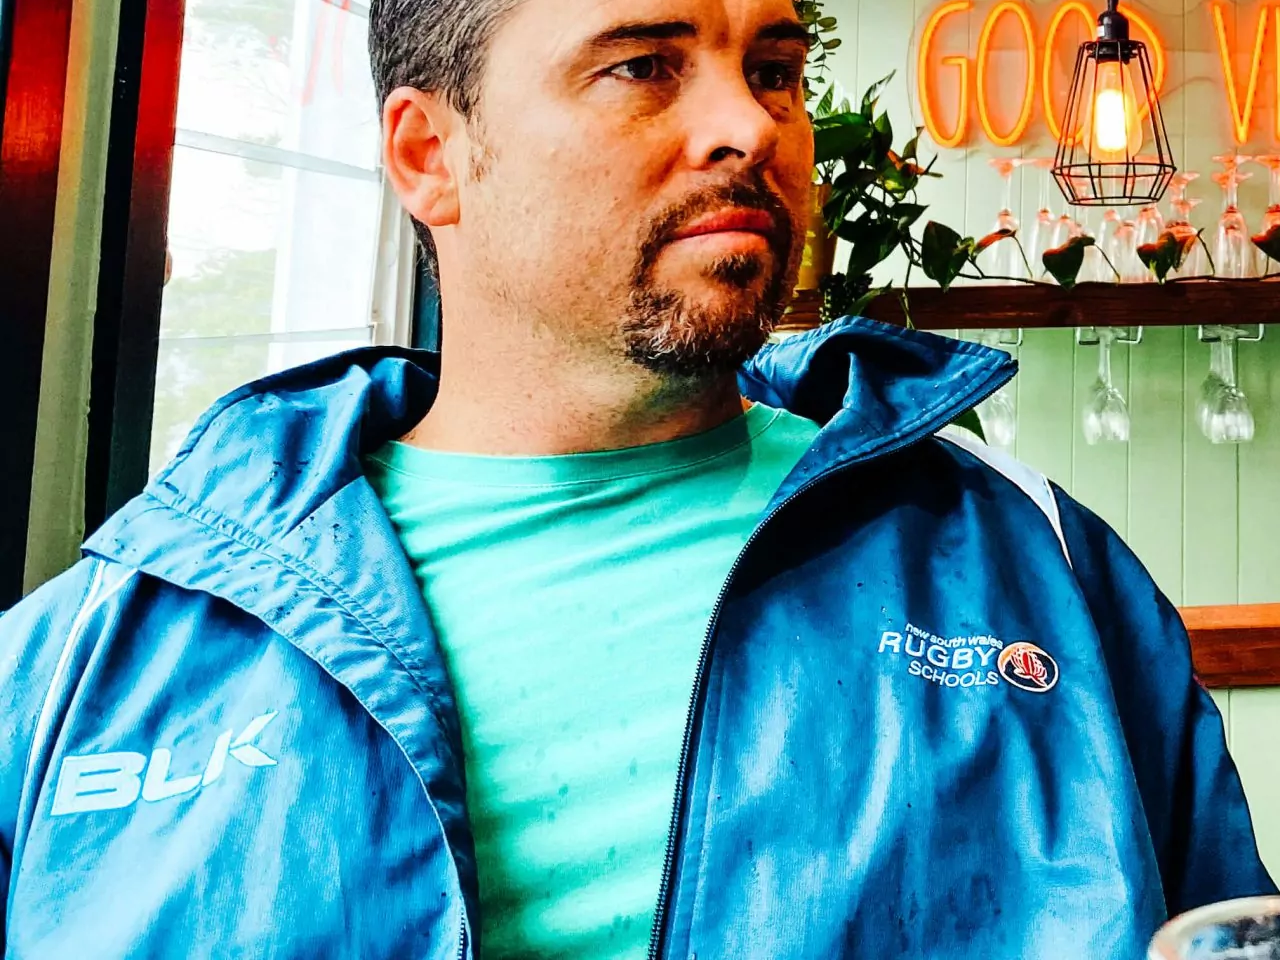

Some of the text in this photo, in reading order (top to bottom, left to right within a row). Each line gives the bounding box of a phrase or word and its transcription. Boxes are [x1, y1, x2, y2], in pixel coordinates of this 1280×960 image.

[877, 631, 997, 670] RUGBY
[905, 623, 1004, 650] new south wales
[908, 659, 999, 688] SCHOOLS
[49, 710, 279, 817] BLK
